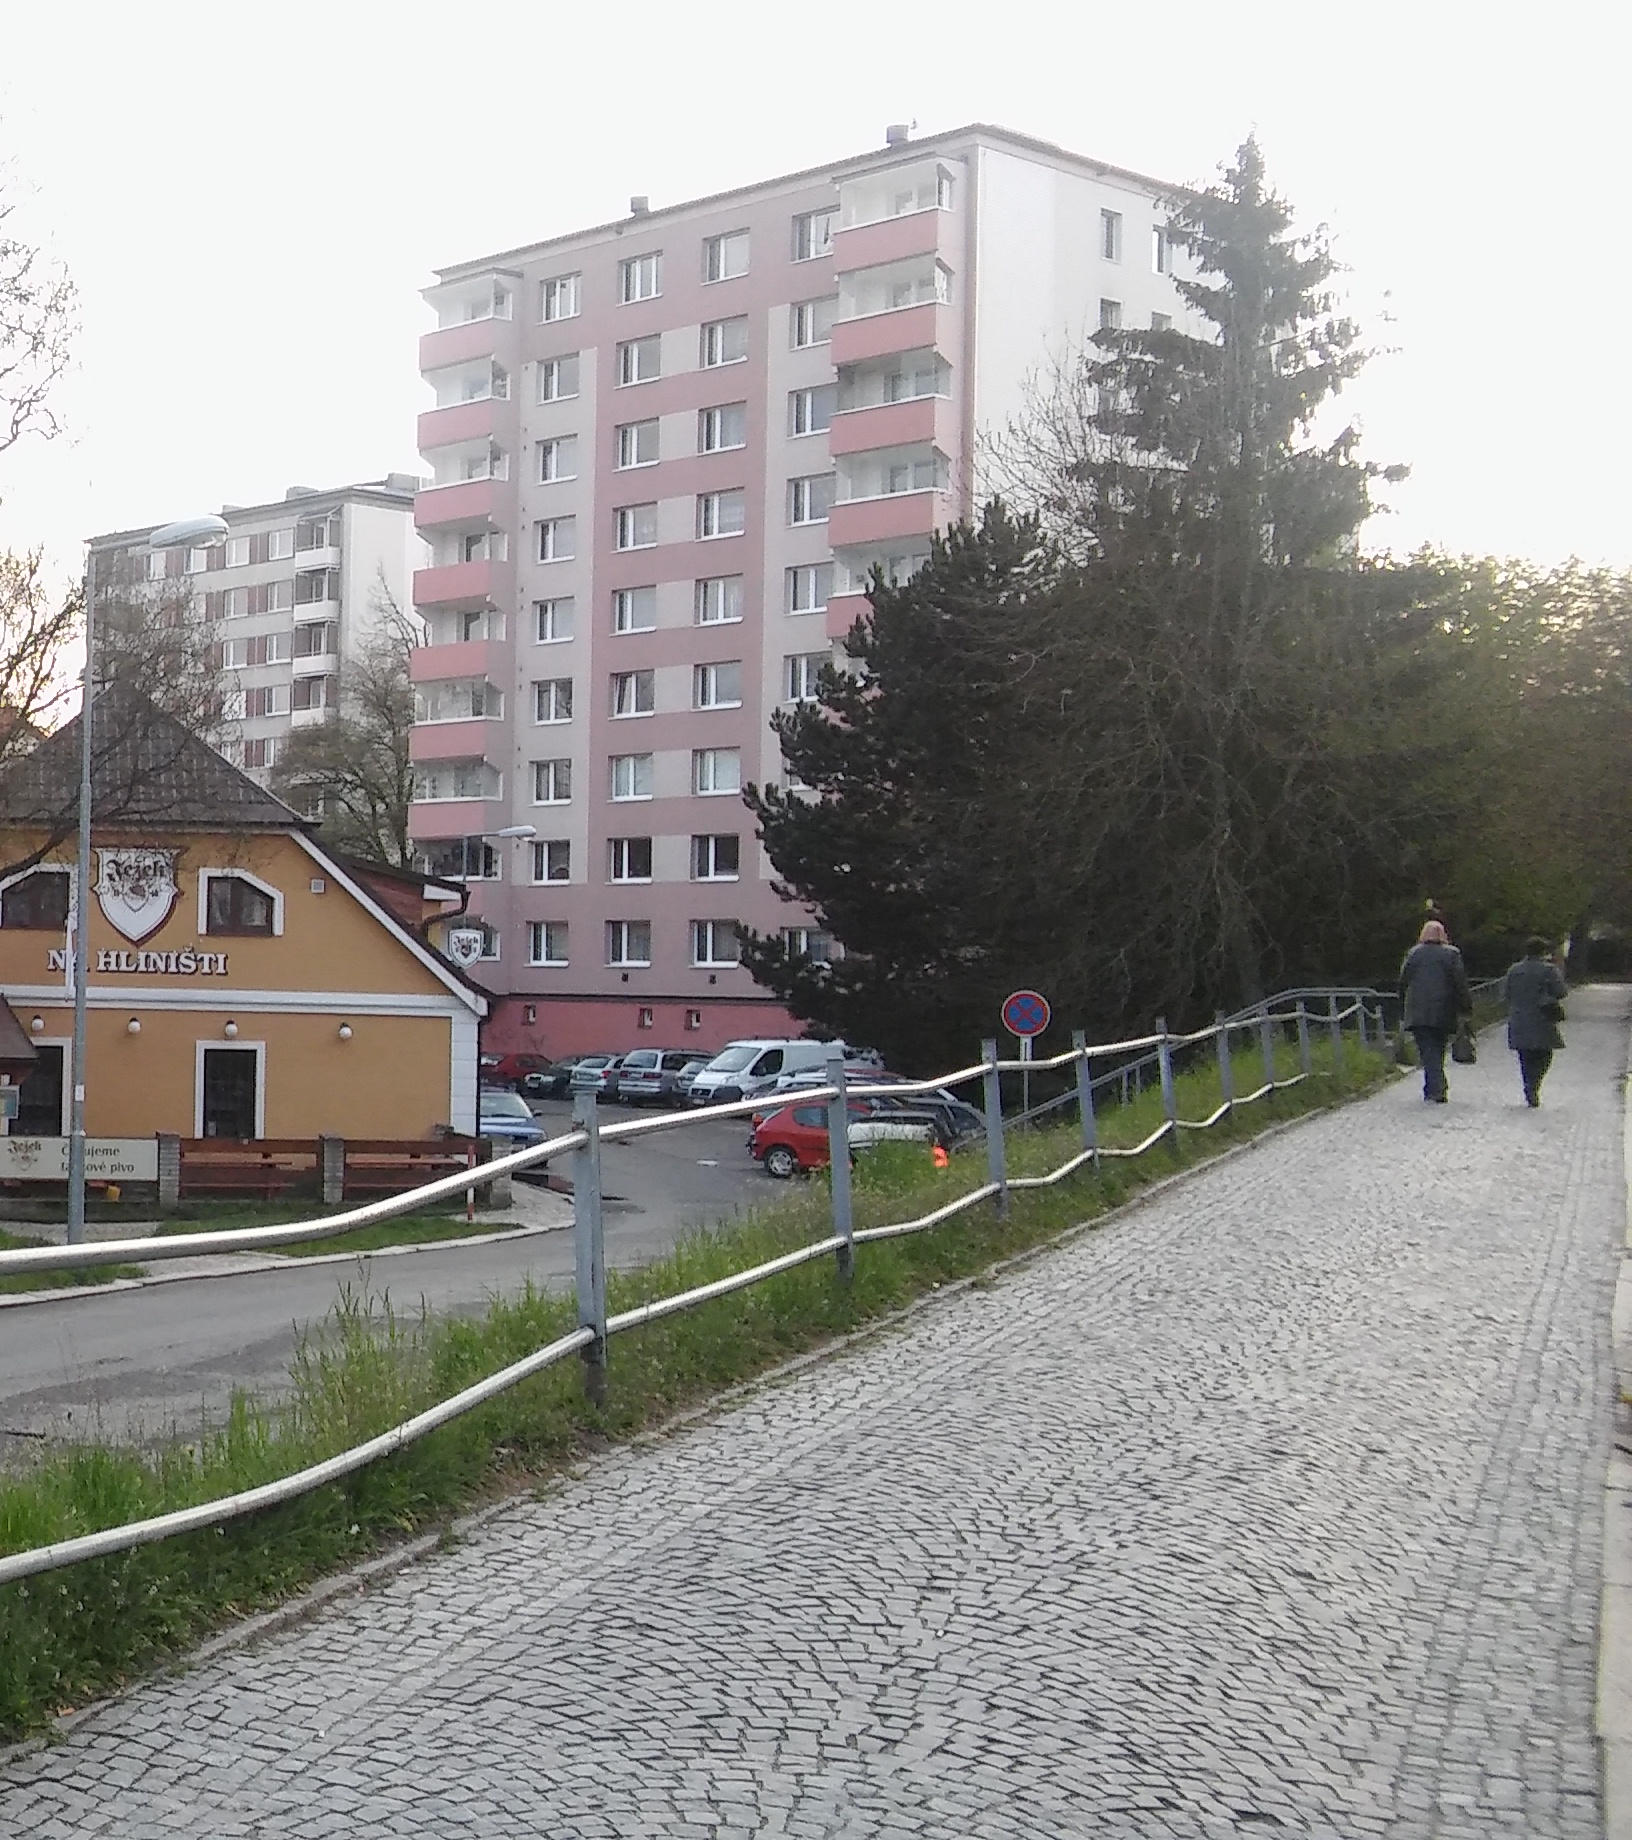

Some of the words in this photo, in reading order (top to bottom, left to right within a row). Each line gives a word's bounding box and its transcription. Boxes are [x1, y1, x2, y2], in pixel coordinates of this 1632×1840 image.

[97, 946, 228, 975] HLINIŠTI
[61, 1143, 121, 1158] Čujeme
[110, 1161, 135, 1175] pivo
